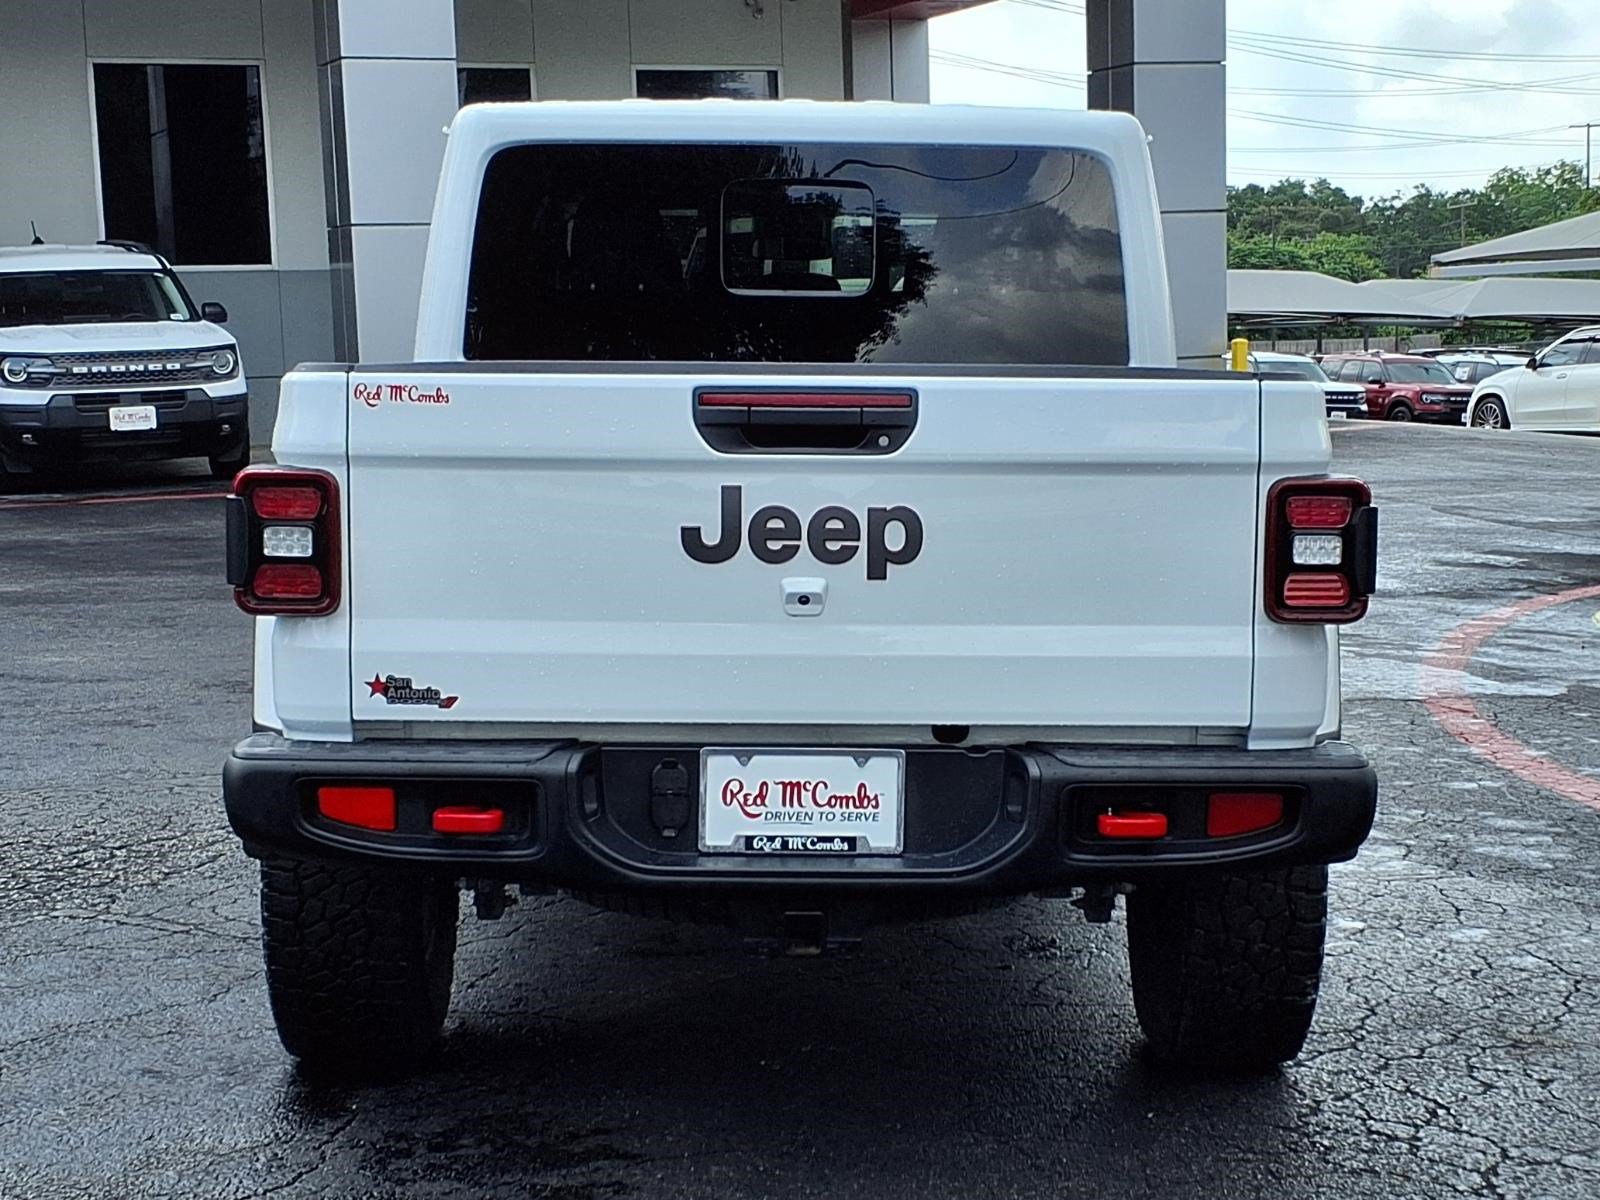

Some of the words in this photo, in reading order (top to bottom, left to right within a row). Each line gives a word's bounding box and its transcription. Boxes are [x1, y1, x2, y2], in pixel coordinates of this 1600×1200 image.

[72, 363, 181, 374] BRONCO
[354, 382, 383, 408] Red
[385, 384, 450, 404] McCombs
[680, 484, 924, 580] Jeep
[386, 677, 411, 687] San
[387, 686, 441, 698] Antonio
[721, 778, 769, 819] Red
[773, 780, 881, 810] McCombs
[763, 811, 815, 823] DRIVEN
[817, 811, 836, 822] TO
[839, 811, 881, 822] SERVE
[752, 836, 782, 851] Red
[784, 836, 849, 851] McCombs
